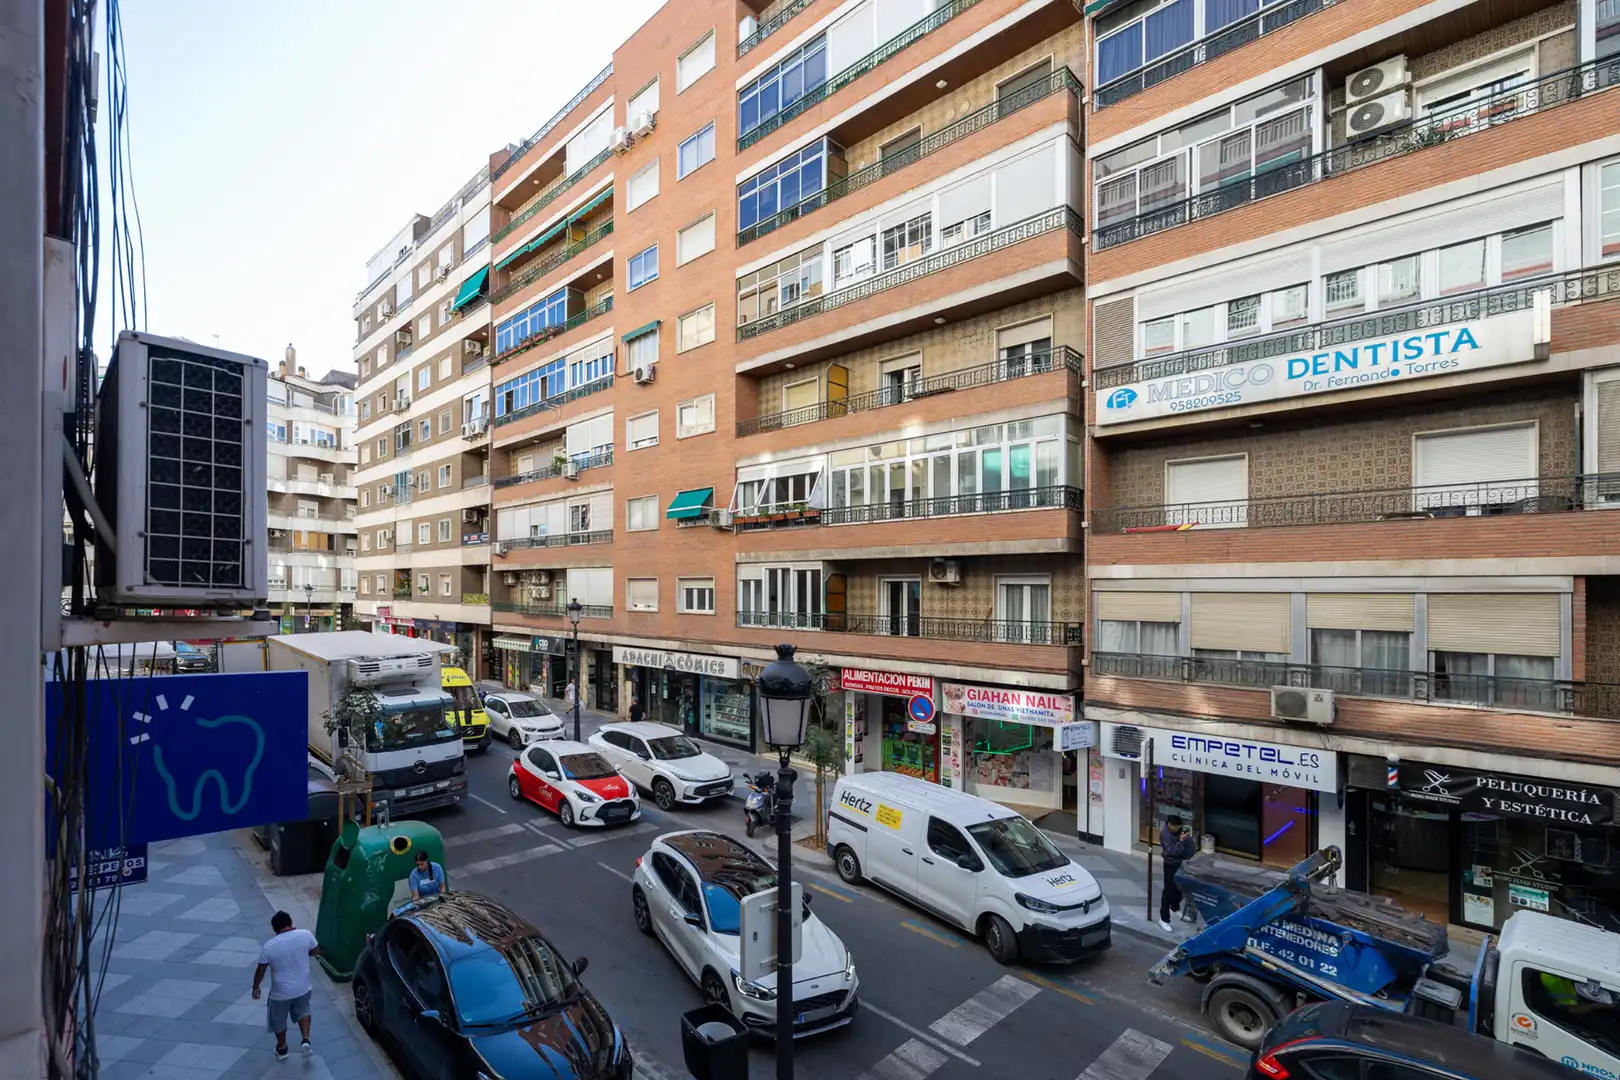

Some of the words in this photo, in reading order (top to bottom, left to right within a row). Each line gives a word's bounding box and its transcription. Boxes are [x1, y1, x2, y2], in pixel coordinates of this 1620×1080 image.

[1146, 363, 1275, 404] MEDICO
[1286, 327, 1482, 380] DENTISTA
[1303, 380, 1322, 392] Dr.
[1405, 358, 1459, 375] Torres
[1170, 391, 1241, 412] 958209525
[843, 669, 906, 687] ALIMENTACION
[907, 675, 930, 689] PEKIN
[967, 688, 1021, 706] GIAHAN
[1026, 694, 1061, 711] NAIL
[1016, 707, 1054, 718] VIETNAMITA
[1171, 753, 1228, 769] CLÍNICA
[1236, 763, 1262, 775] DEL
[1271, 768, 1319, 783] MÓVIL
[840, 790, 872, 813] Hertz
[1475, 776, 1602, 806] PELUQUERÍA
[1481, 796, 1496, 809] Y
[1499, 800, 1594, 825] ESTÉTICA
[1046, 874, 1076, 887] Hertz
[1532, 882, 1559, 892] STUDIO
[1255, 924, 1338, 957] NTENEDORES
[1282, 919, 1339, 947] MEDINA
[1278, 949, 1295, 961] 42
[1298, 955, 1315, 969] 01
[1319, 962, 1338, 977] 22
